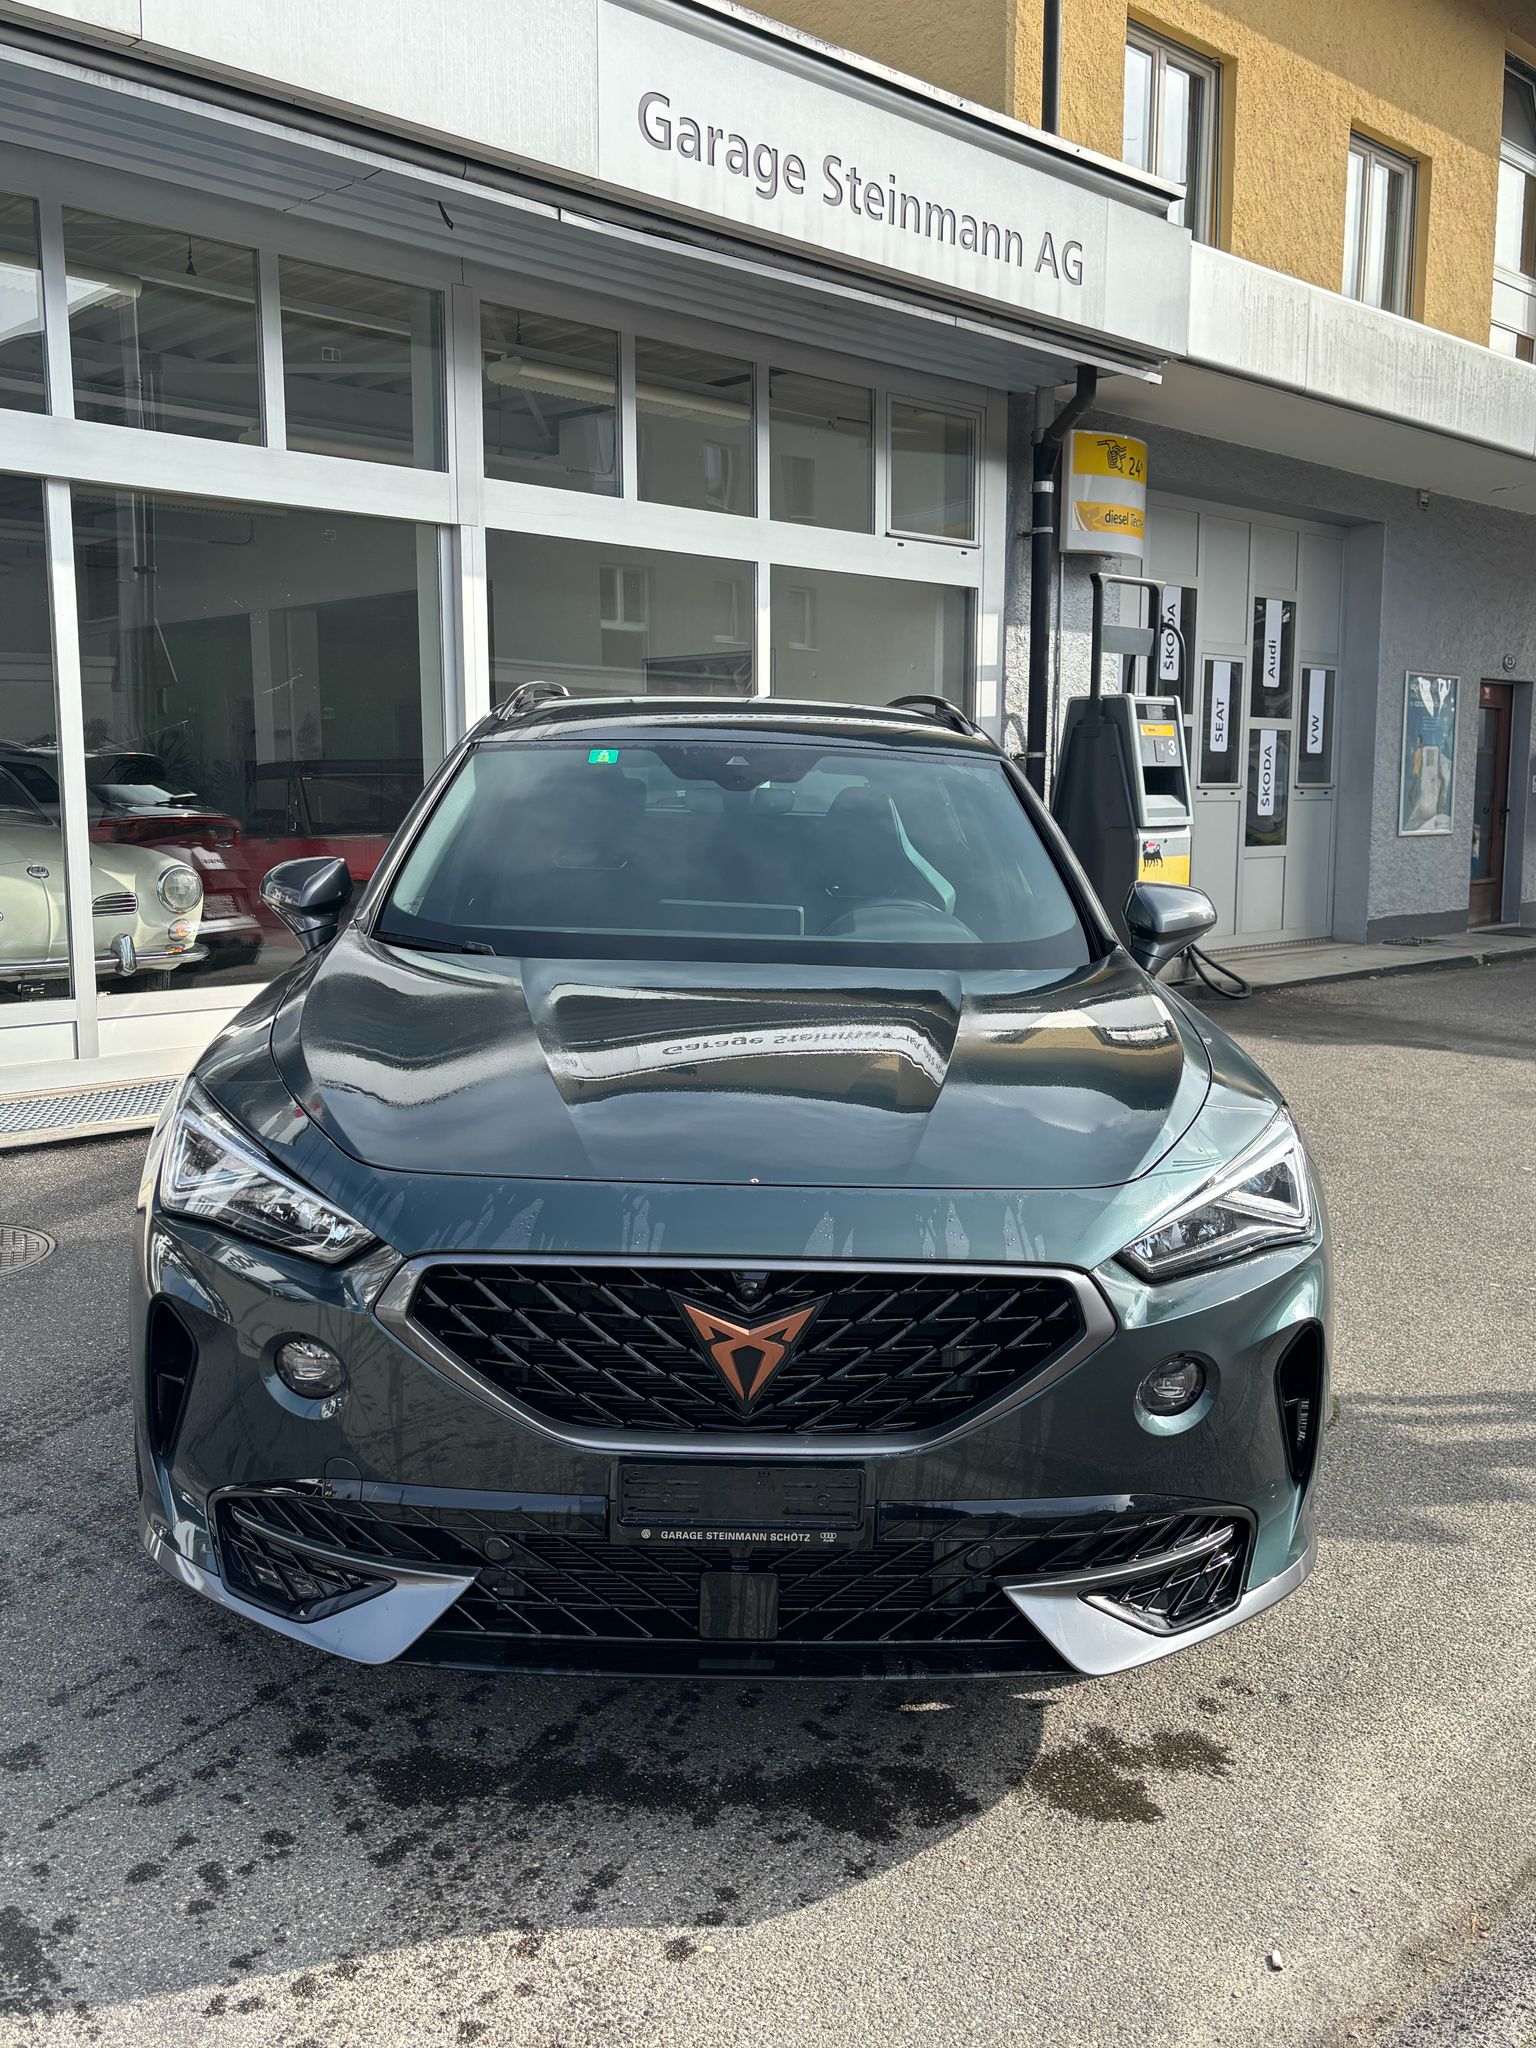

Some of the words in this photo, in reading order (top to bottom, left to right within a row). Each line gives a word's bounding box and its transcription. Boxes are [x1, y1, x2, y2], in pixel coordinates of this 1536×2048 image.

[637, 91, 806, 200] Garage
[822, 154, 1023, 267] Steinmann
[1034, 231, 1084, 286] AG
[1104, 509, 1129, 525] diesel
[1268, 639, 1277, 679] Audi
[1215, 697, 1225, 742] SEAT
[1311, 715, 1320, 745] VW
[1168, 740, 1177, 756] 3
[1260, 745, 1272, 807] ŠKODA
[660, 1530, 703, 1541] GARAGE
[706, 1531, 767, 1542] STEINMANN
[770, 1532, 811, 1543] SCHÖTZ
